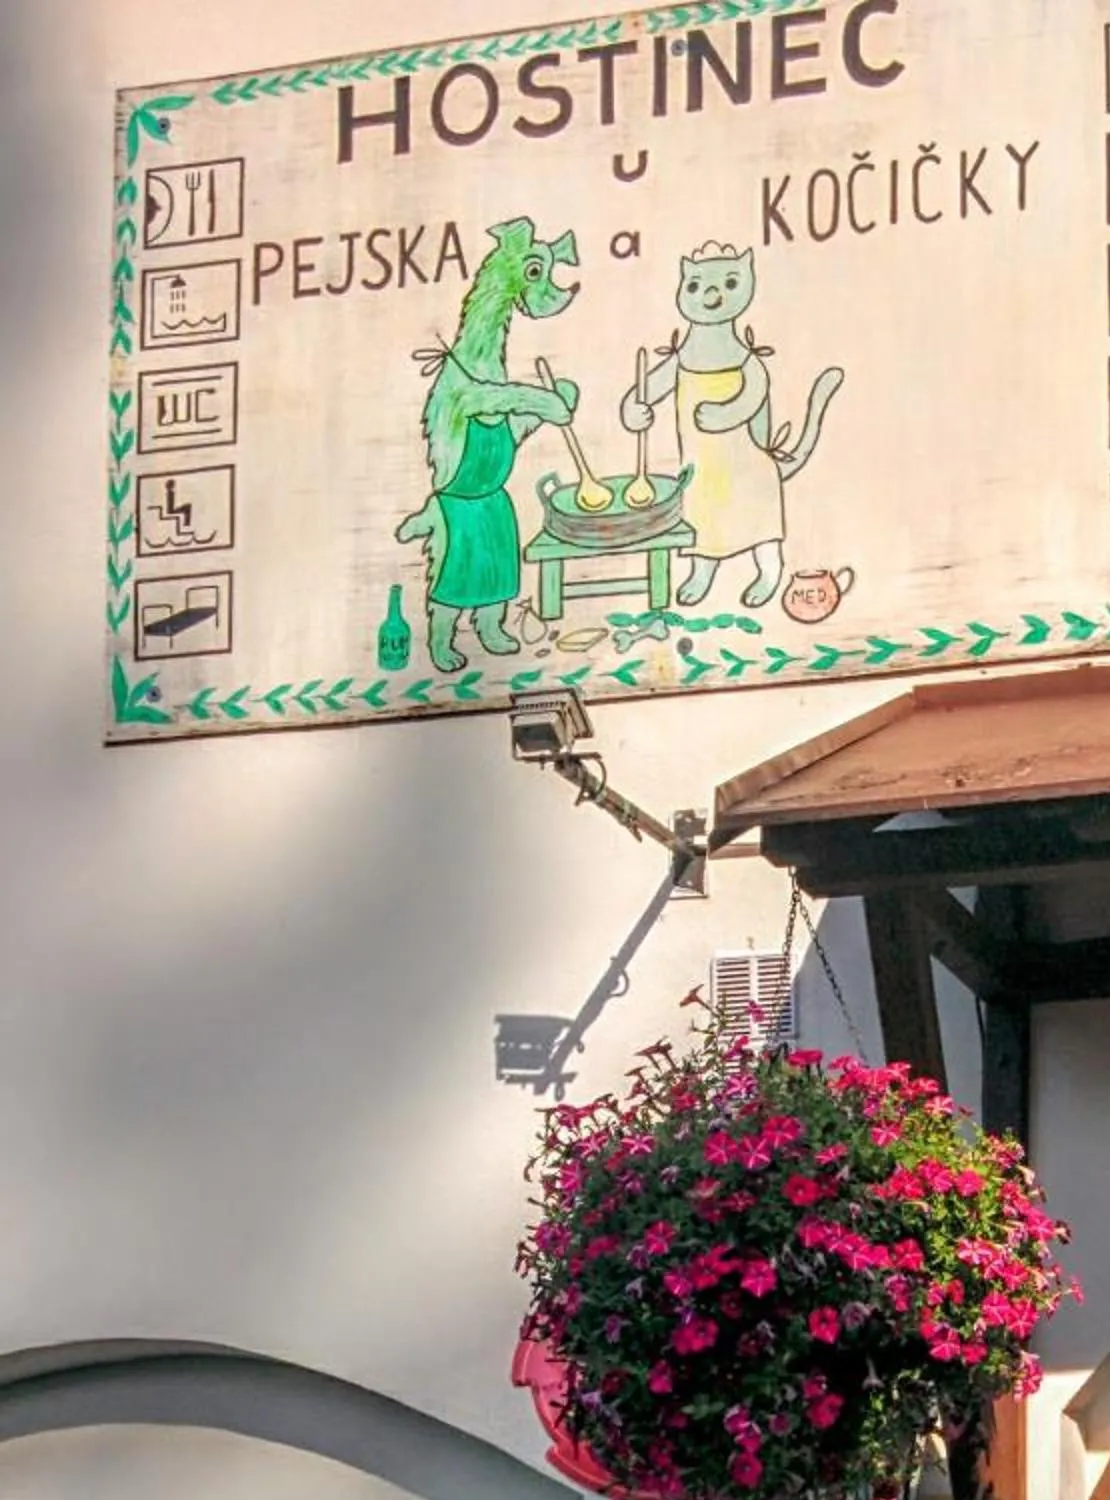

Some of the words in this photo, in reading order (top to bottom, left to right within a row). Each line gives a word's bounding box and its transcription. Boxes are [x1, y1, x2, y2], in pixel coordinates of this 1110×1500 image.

[337, 0, 905, 164] HOSTINEC
[252, 221, 469, 306] PEJSKA
[609, 231, 641, 260] a
[762, 141, 1040, 246] KOČIČKY
